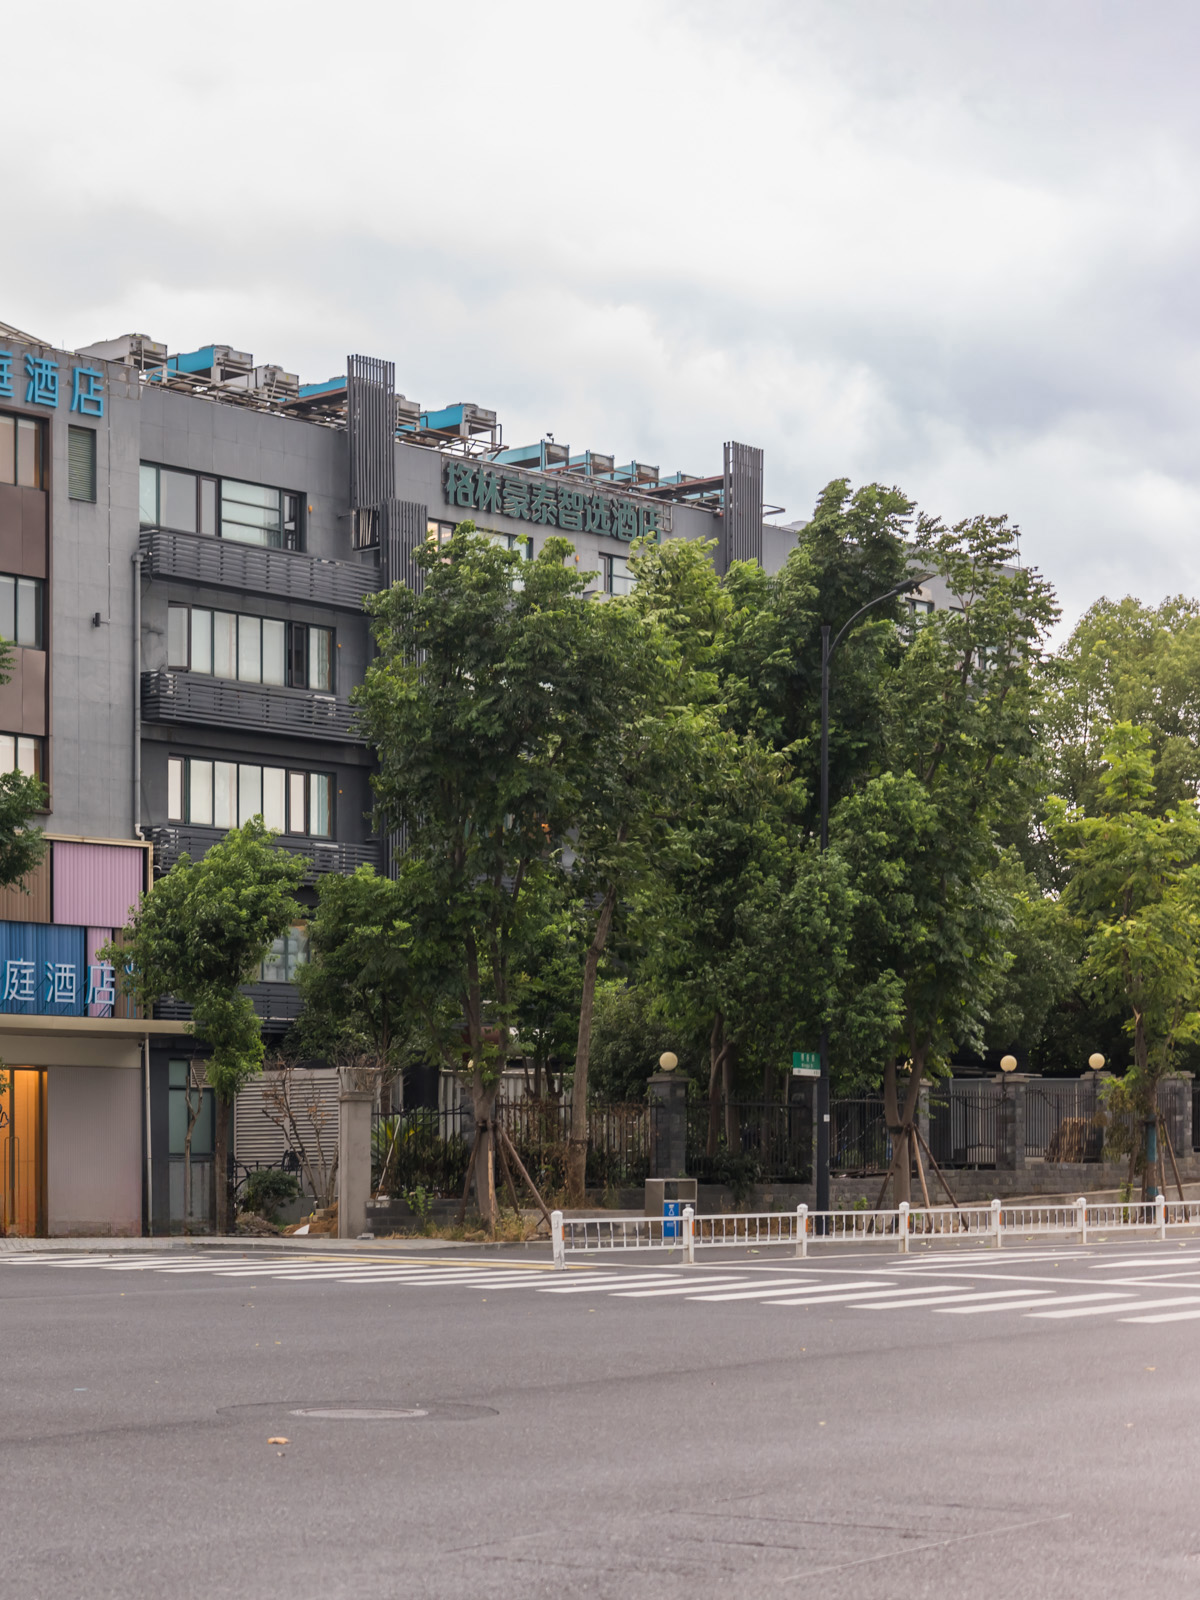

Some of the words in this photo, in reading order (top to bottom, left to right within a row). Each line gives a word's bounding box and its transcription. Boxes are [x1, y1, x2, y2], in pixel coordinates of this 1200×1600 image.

[445, 462, 661, 545] 格林豪泰智选酒店
